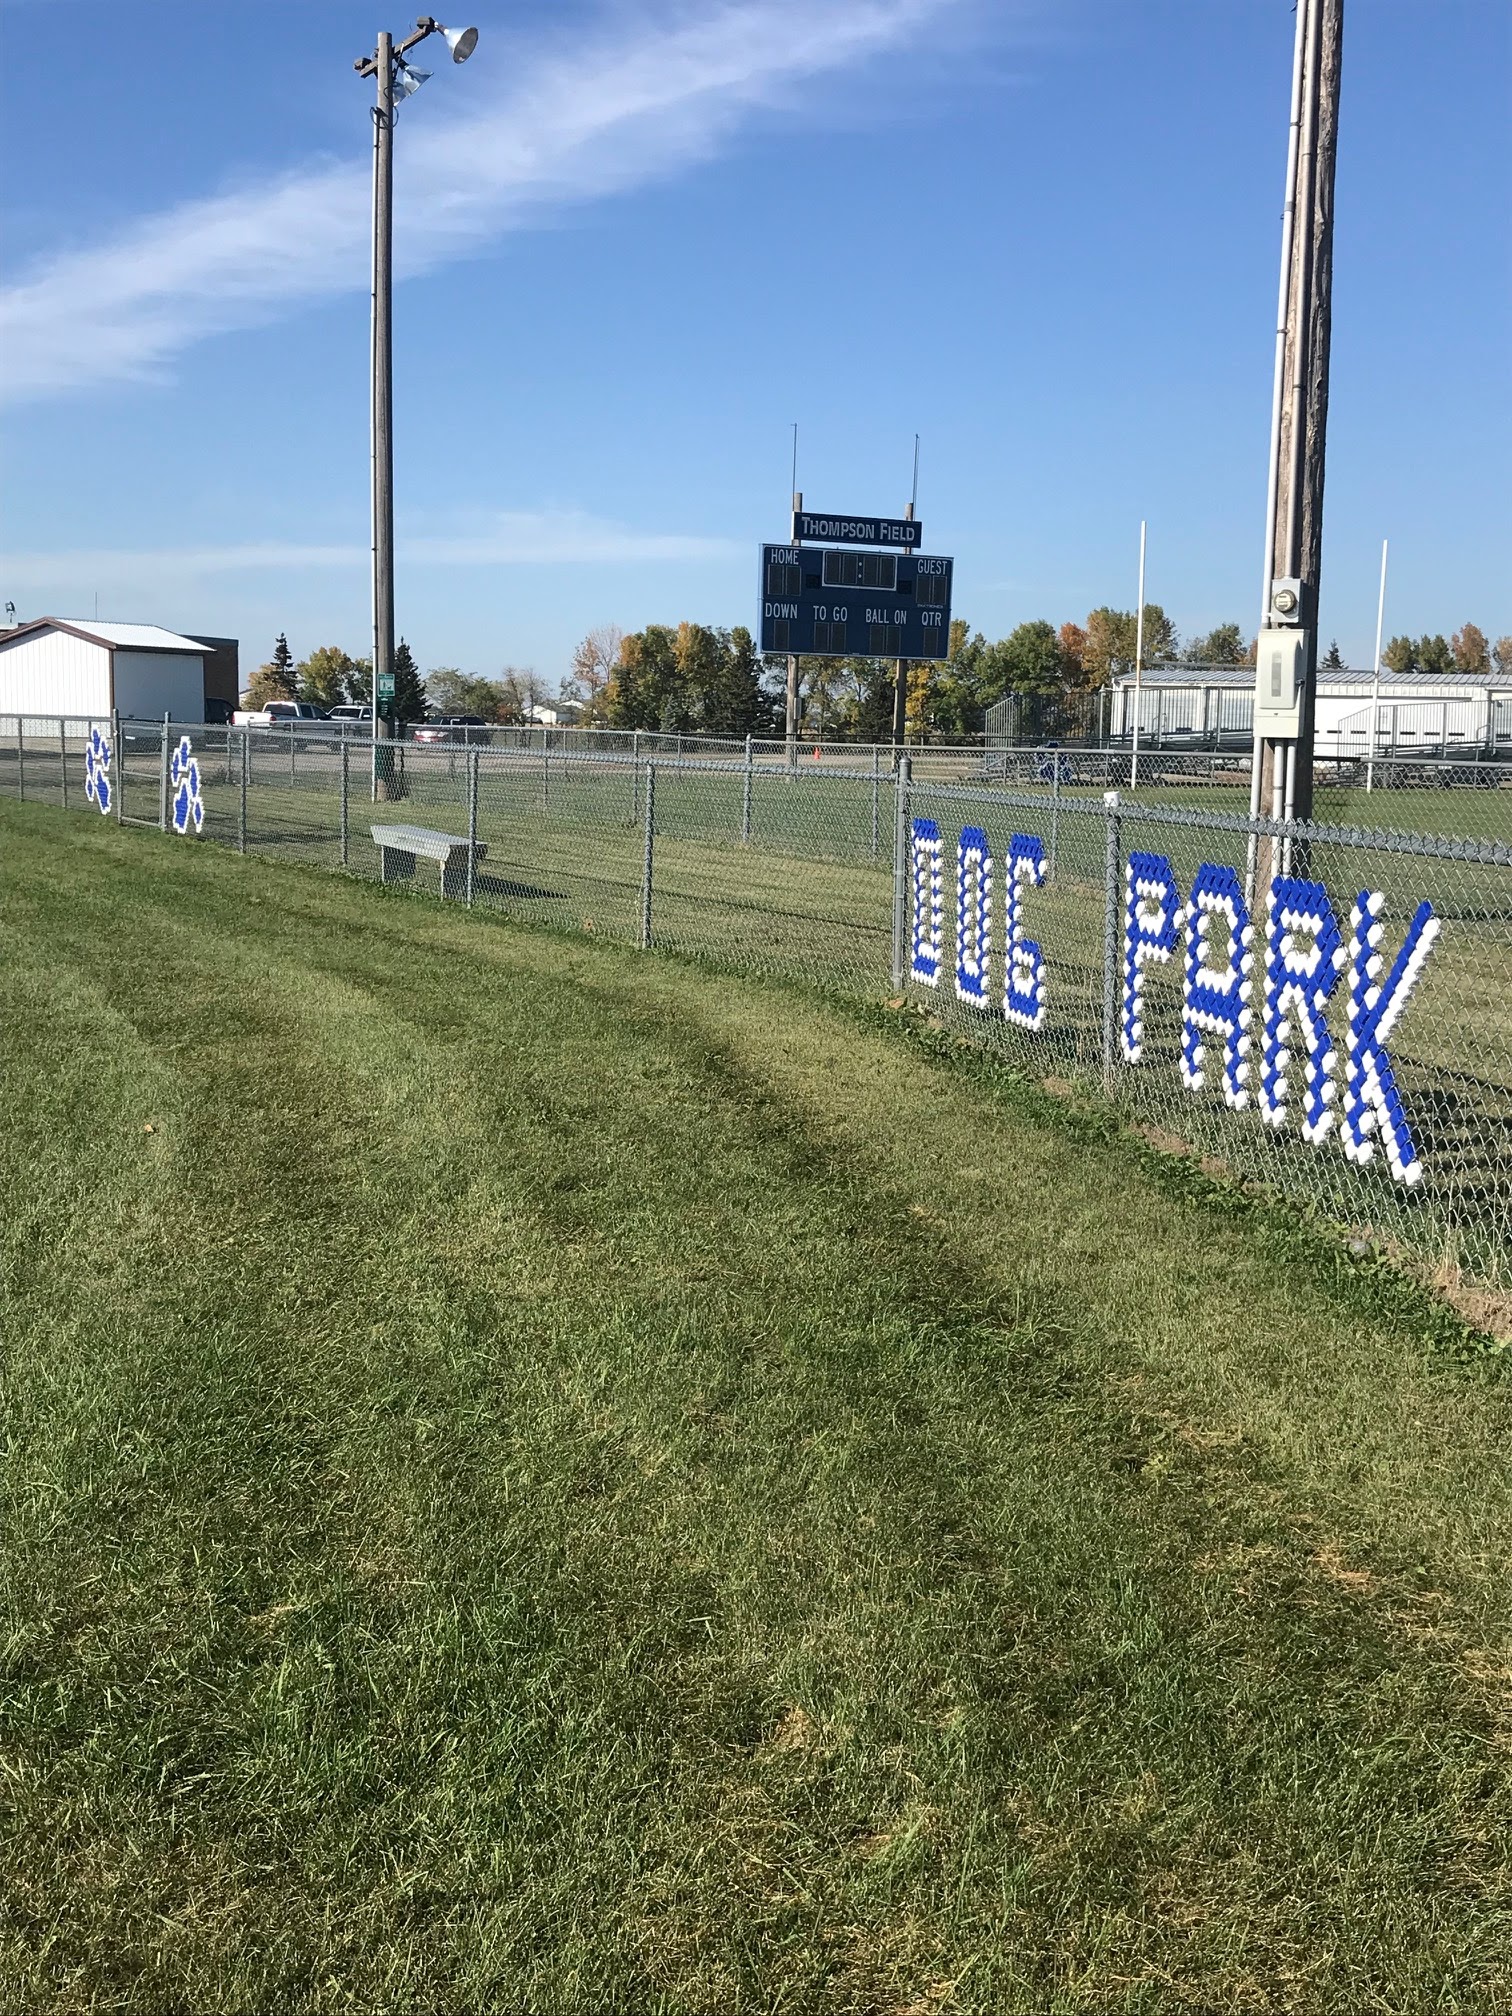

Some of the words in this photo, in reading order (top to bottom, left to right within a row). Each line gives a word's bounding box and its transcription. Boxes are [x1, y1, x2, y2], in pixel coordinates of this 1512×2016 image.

[801, 516, 875, 540] THOMPSON
[880, 522, 915, 542] FIELD
[771, 548, 800, 565] HOME
[917, 558, 948, 575] GUEST
[765, 602, 798, 619] DOWN
[813, 605, 827, 621] TO
[833, 606, 848, 622] GO
[865, 608, 889, 624] BALL
[894, 610, 907, 625] ON
[921, 612, 942, 627] QTR
[911, 817, 1047, 1032] DOG
[1120, 850, 1442, 1187] PARK
